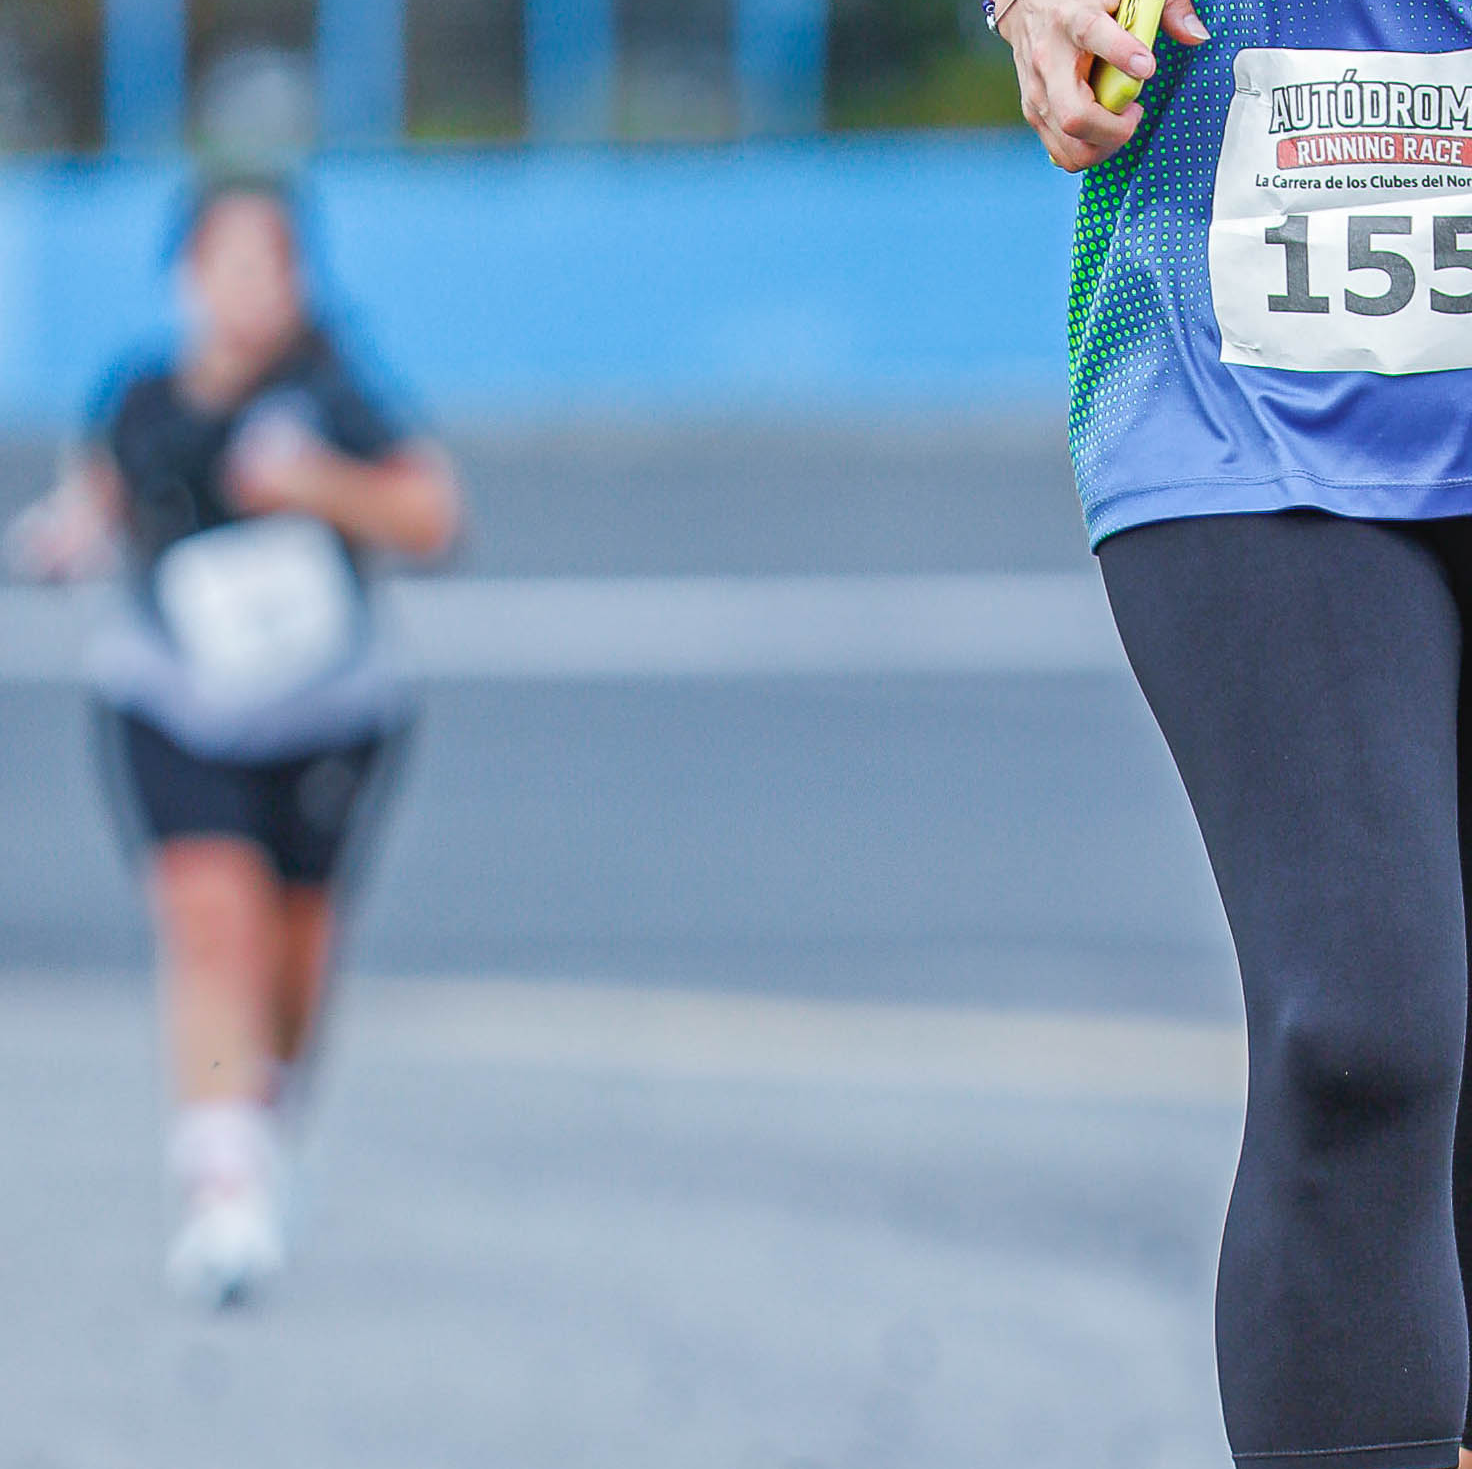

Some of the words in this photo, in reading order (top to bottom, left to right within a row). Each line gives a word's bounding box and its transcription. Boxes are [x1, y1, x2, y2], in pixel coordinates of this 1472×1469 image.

[1297, 135, 1395, 165] RUNNING
[1402, 135, 1465, 166] RACE
[1255, 173, 1269, 188] La
[1272, 174, 1322, 189] Carrera
[1324, 175, 1343, 189] de
[1346, 175, 1367, 189] los
[1370, 174, 1418, 188] Clubes
[1421, 174, 1443, 188] del
